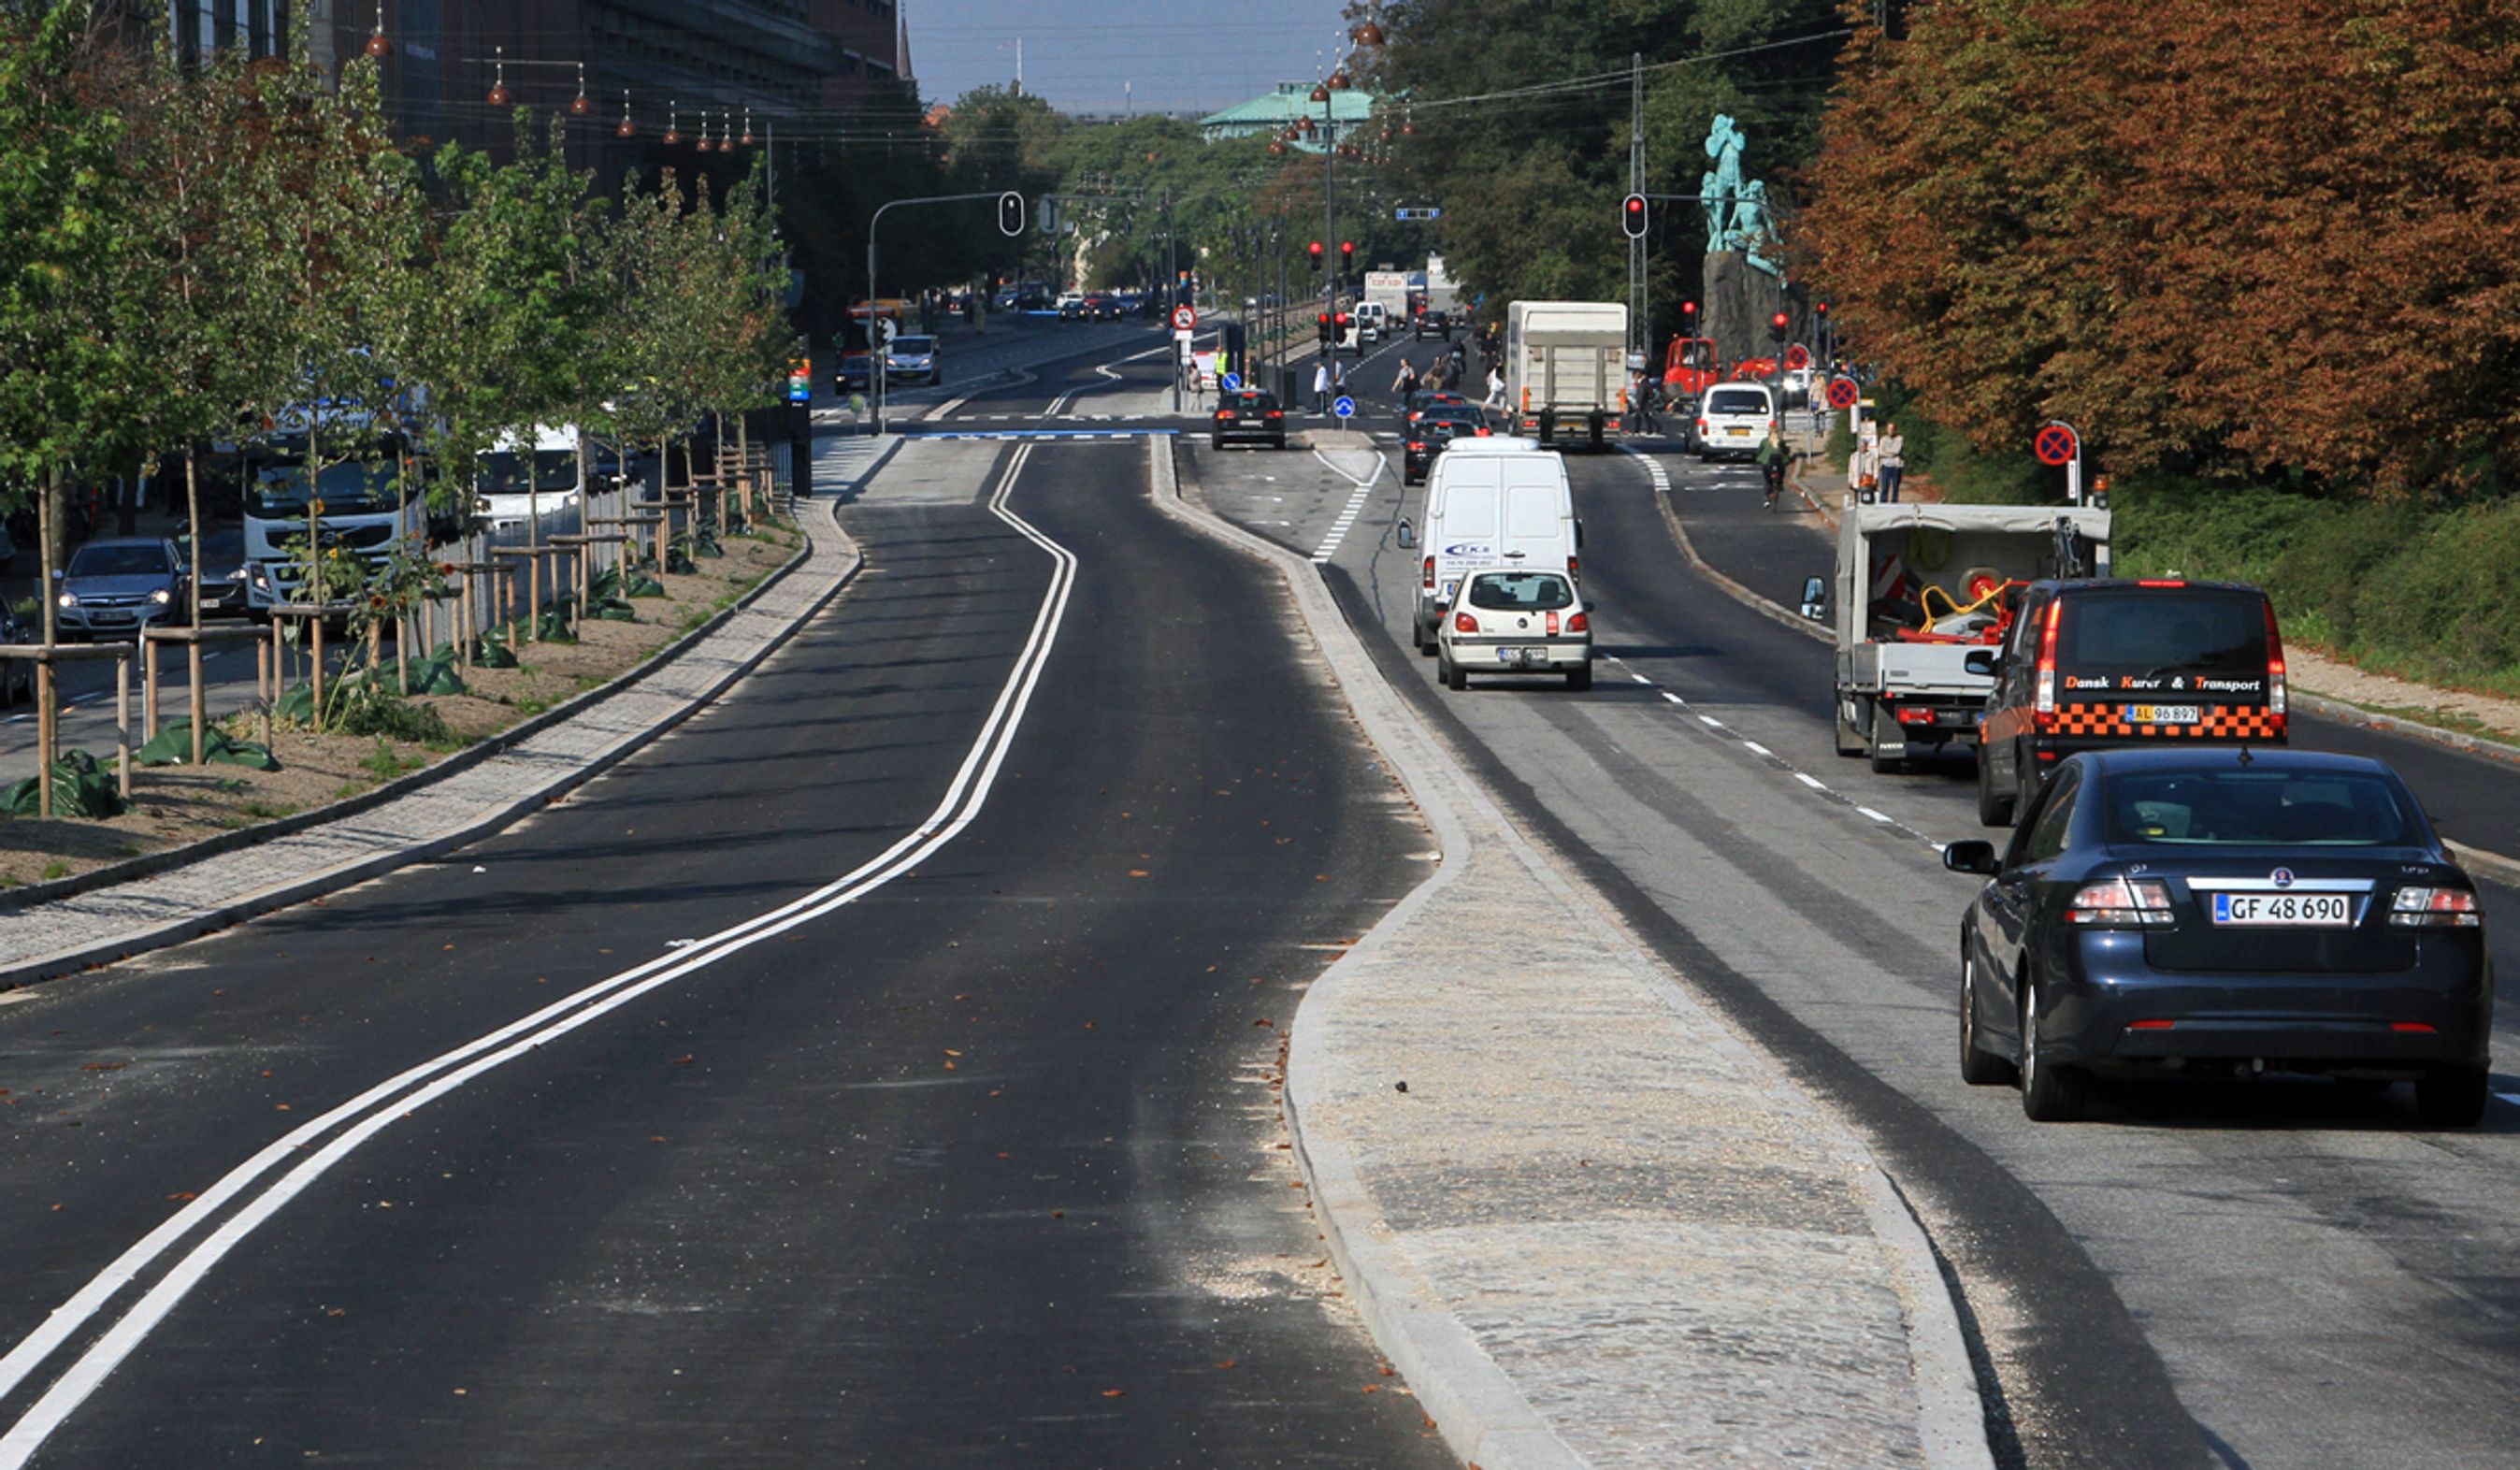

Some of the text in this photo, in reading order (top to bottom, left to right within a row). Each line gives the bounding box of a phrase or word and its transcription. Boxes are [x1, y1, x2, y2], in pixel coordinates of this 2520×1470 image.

[2065, 675, 2110, 689] Dansk
[2170, 676, 2185, 689] &
[2194, 675, 2261, 693] Transport
[2136, 706, 2152, 720] AL
[2231, 898, 2345, 919] GF 48 690
